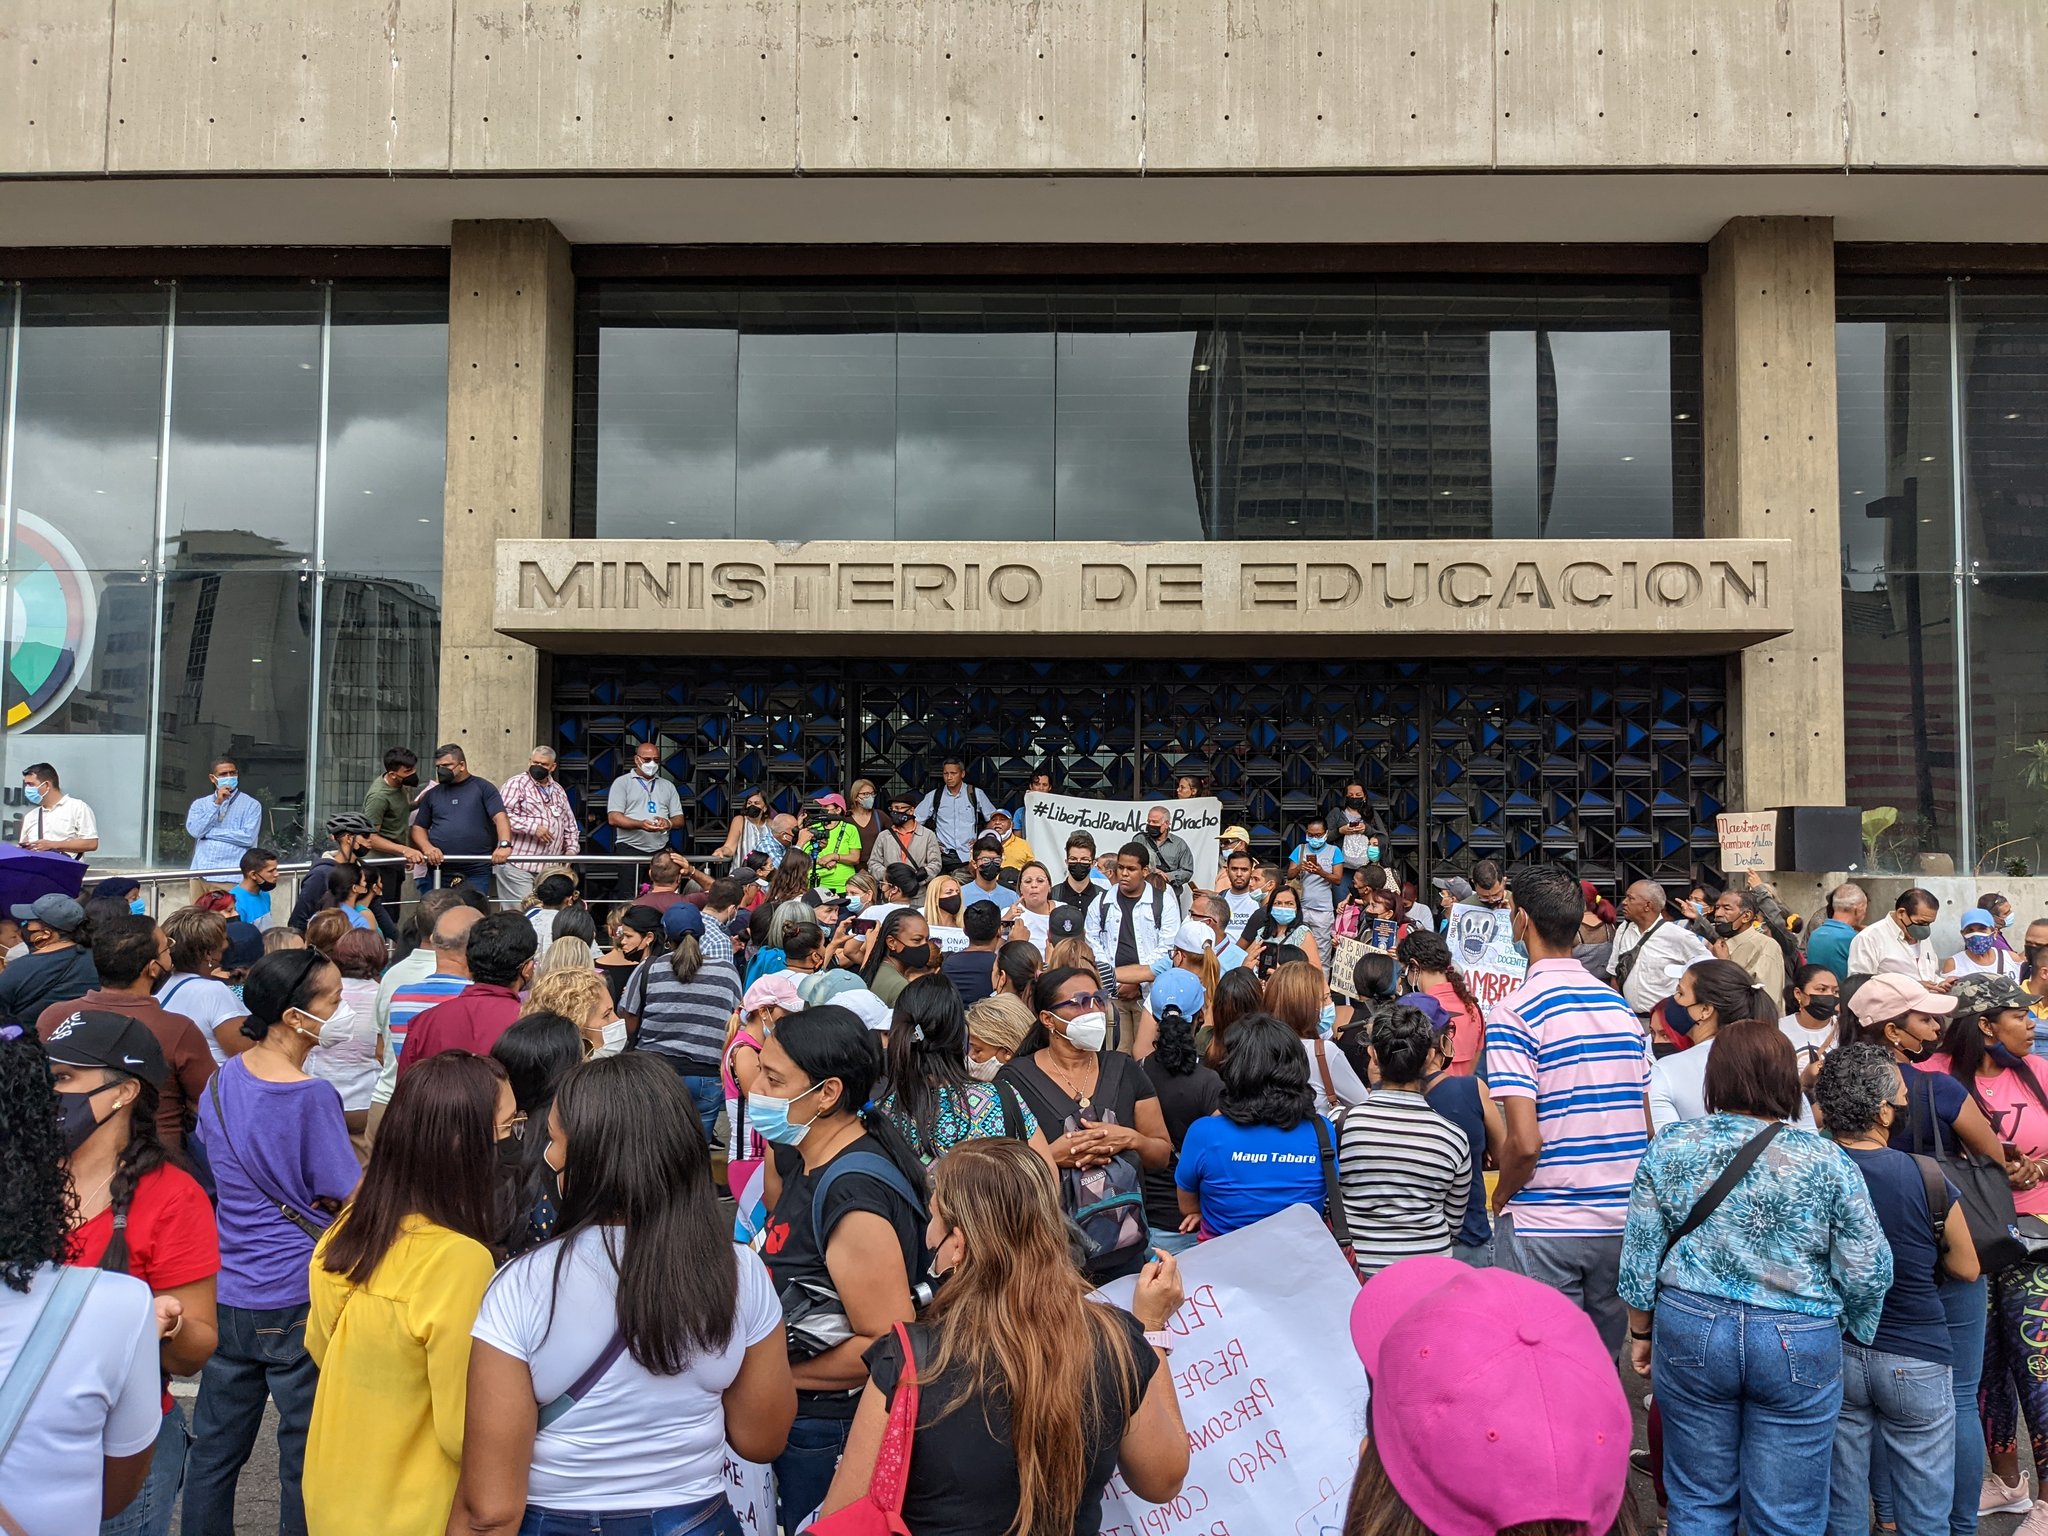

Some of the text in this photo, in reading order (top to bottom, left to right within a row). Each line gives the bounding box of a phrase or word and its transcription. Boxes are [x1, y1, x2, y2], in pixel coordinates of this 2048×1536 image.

[518, 561, 1769, 612] MINISTERIO DE EDUCACION
[1717, 818, 1772, 834] Maestros con
[1721, 835, 1751, 850] hambre
[1498, 954, 1526, 968] DOCENTE
[1463, 970, 1523, 1005] AMBRE
[1231, 1151, 1268, 1163] Mayo
